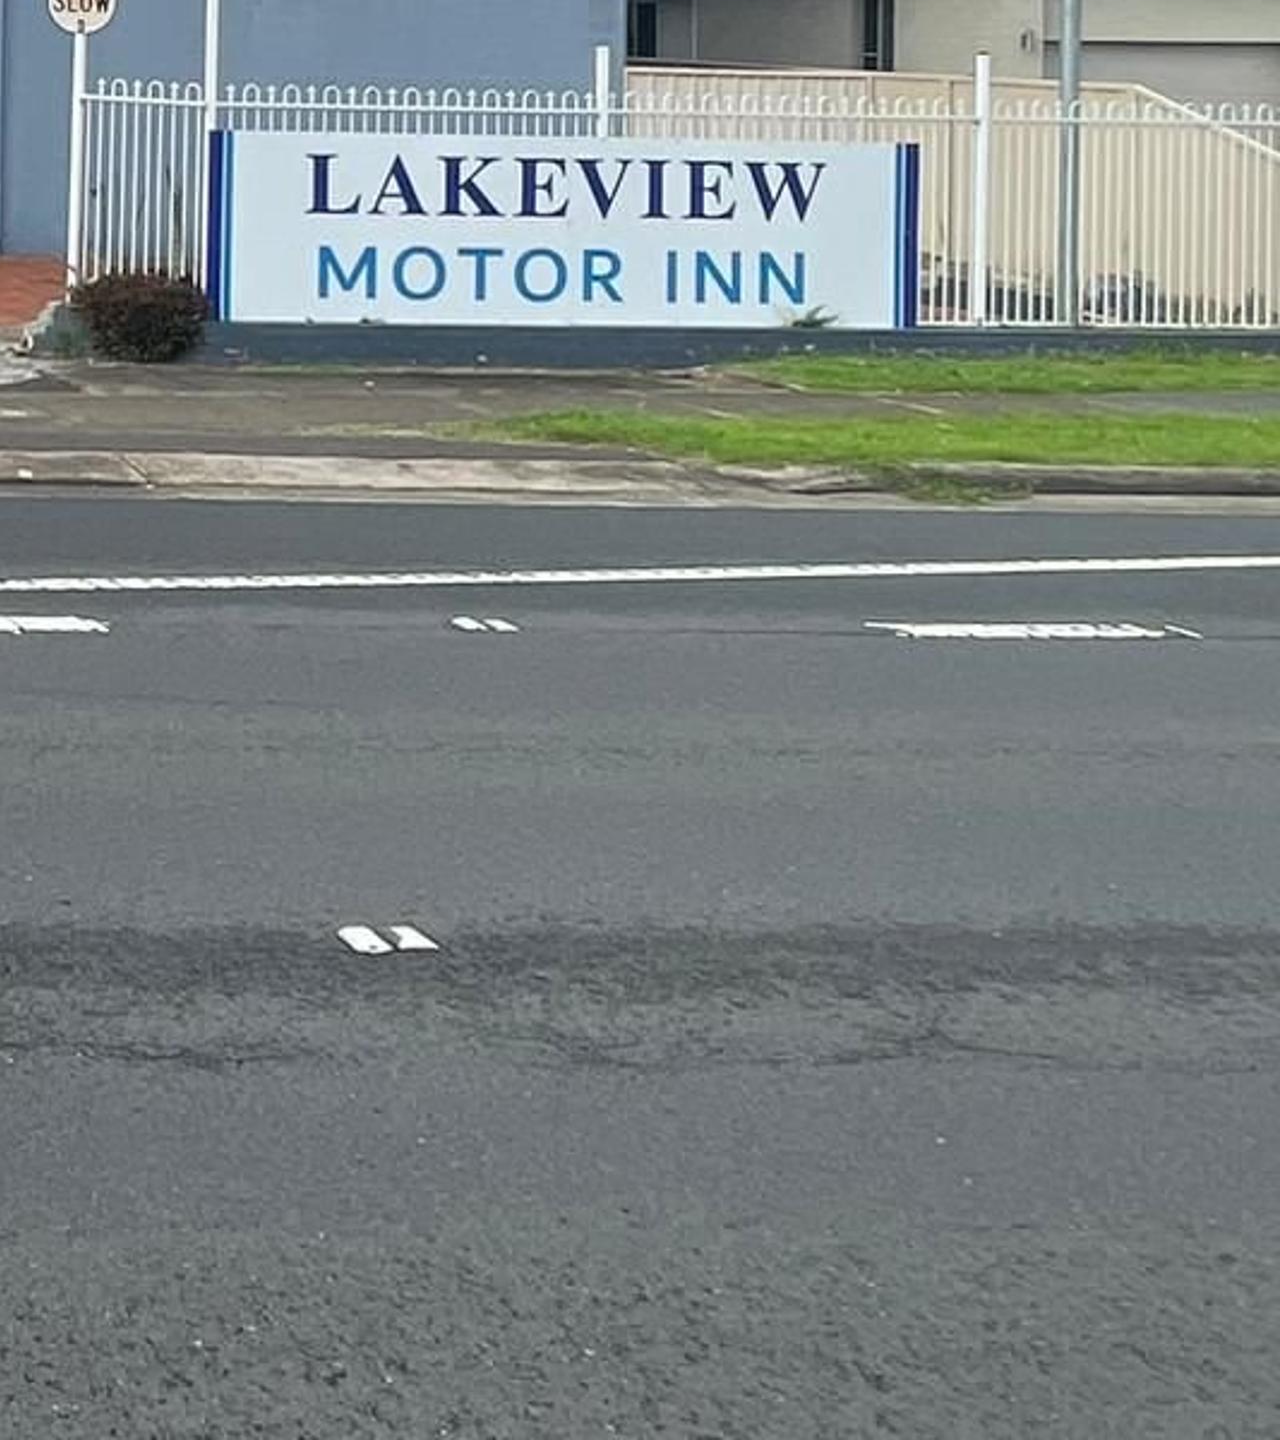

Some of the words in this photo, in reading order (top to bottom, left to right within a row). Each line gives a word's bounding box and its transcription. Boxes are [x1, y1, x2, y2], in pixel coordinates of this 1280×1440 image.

[304, 152, 828, 223] LAKEVIEW
[317, 244, 623, 304] MOTOR
[666, 250, 807, 306] INN
